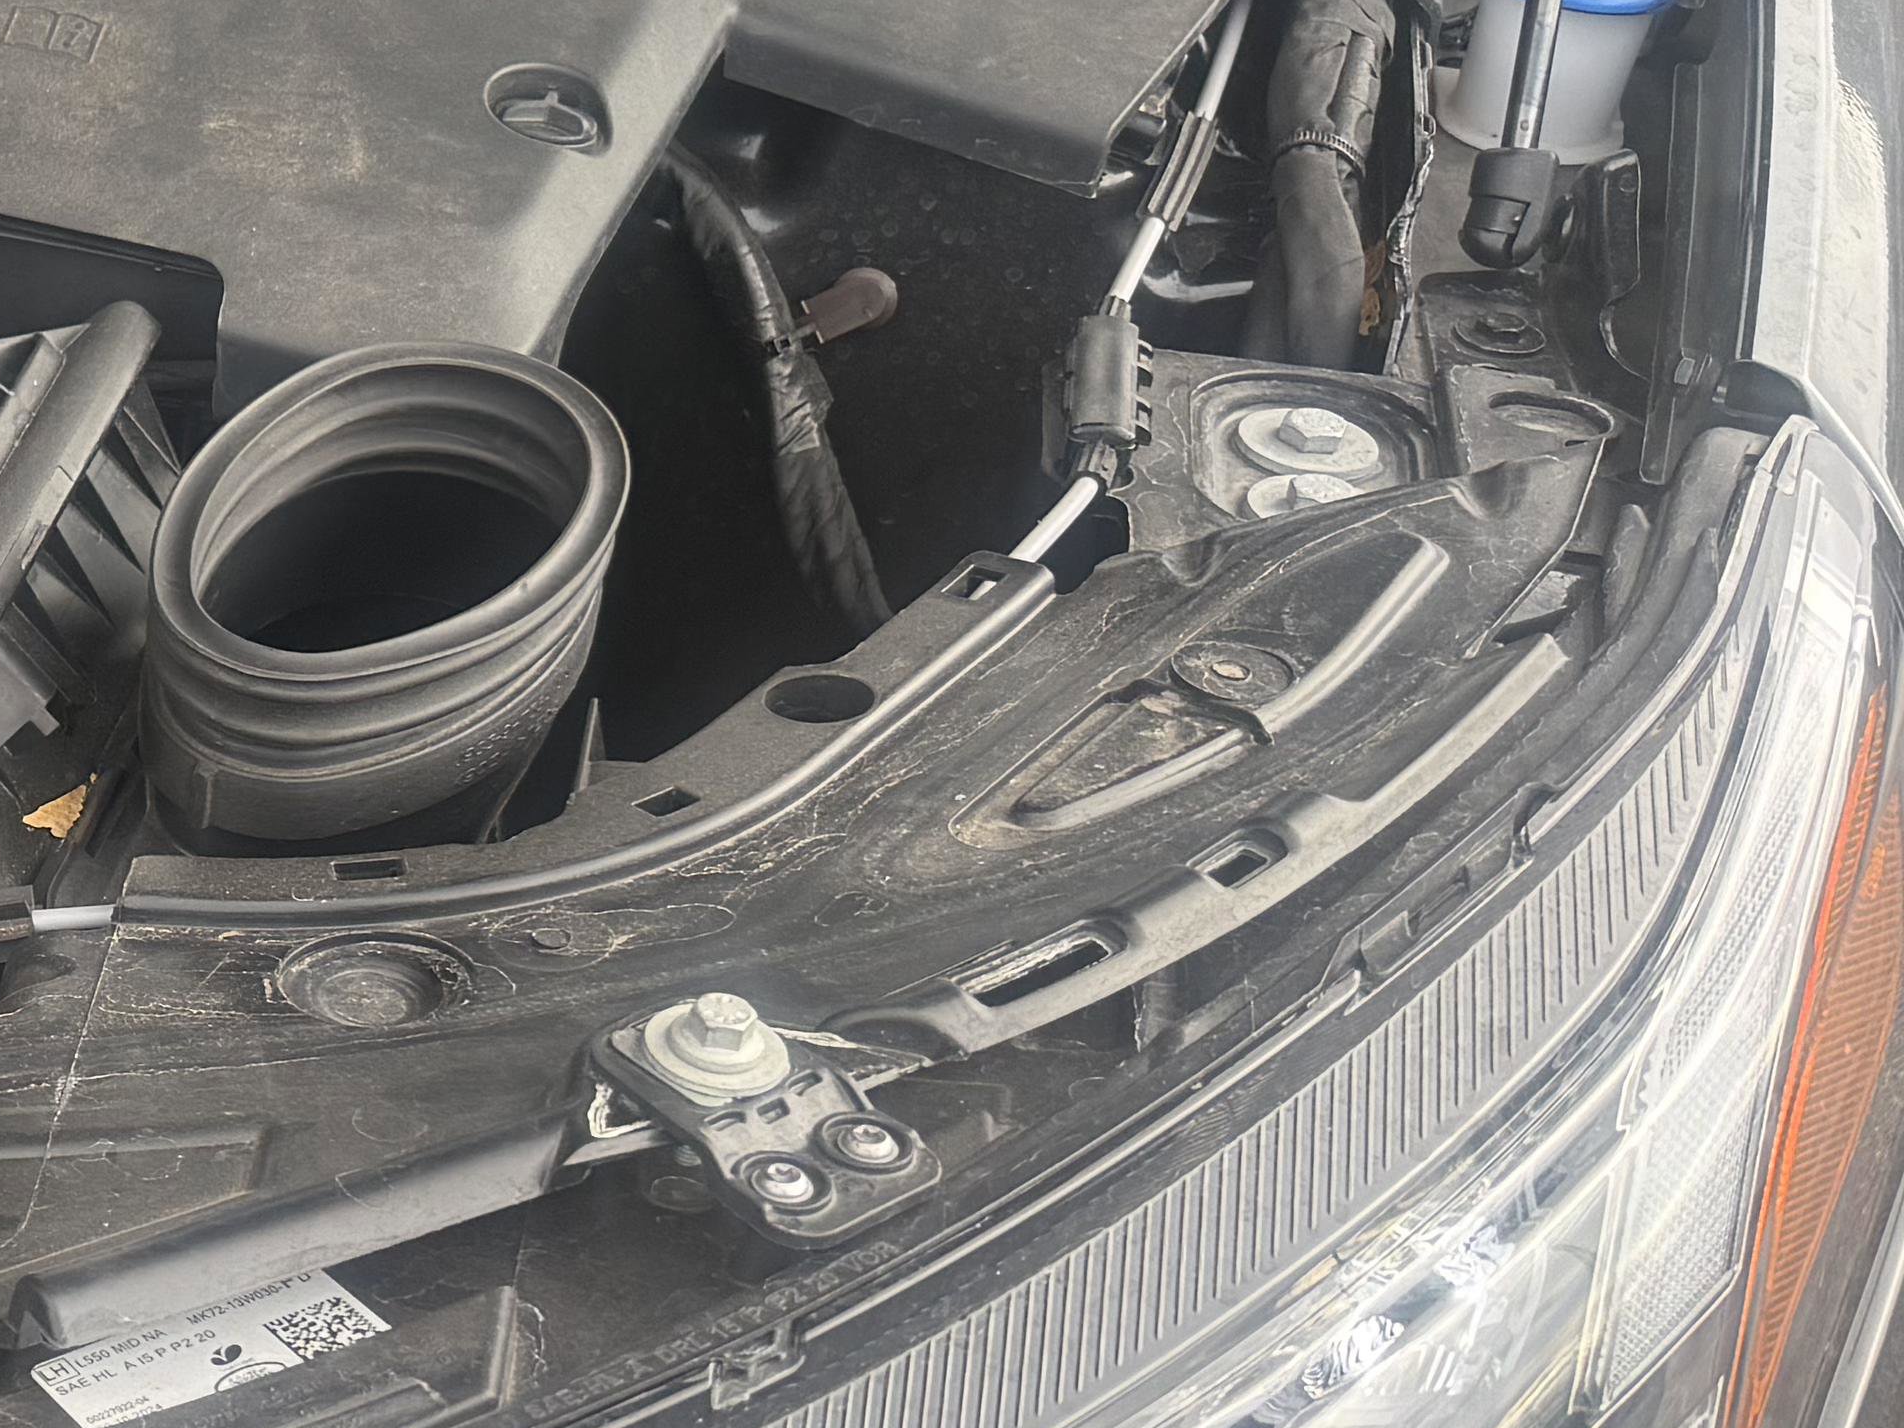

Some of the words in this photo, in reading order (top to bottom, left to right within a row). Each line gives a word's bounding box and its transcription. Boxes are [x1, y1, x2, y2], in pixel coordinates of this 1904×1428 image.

[40, 1363, 70, 1382] LH
[74, 1349, 110, 1369] L550
[111, 1337, 141, 1355] MID
[142, 1328, 168, 1342] NA
[55, 1377, 92, 1396] SAE
[92, 1368, 118, 1383] HL
[124, 1360, 137, 1371] A
[155, 1346, 167, 1358] P
[170, 1338, 193, 1352] P2
[194, 1328, 216, 1343] 20
